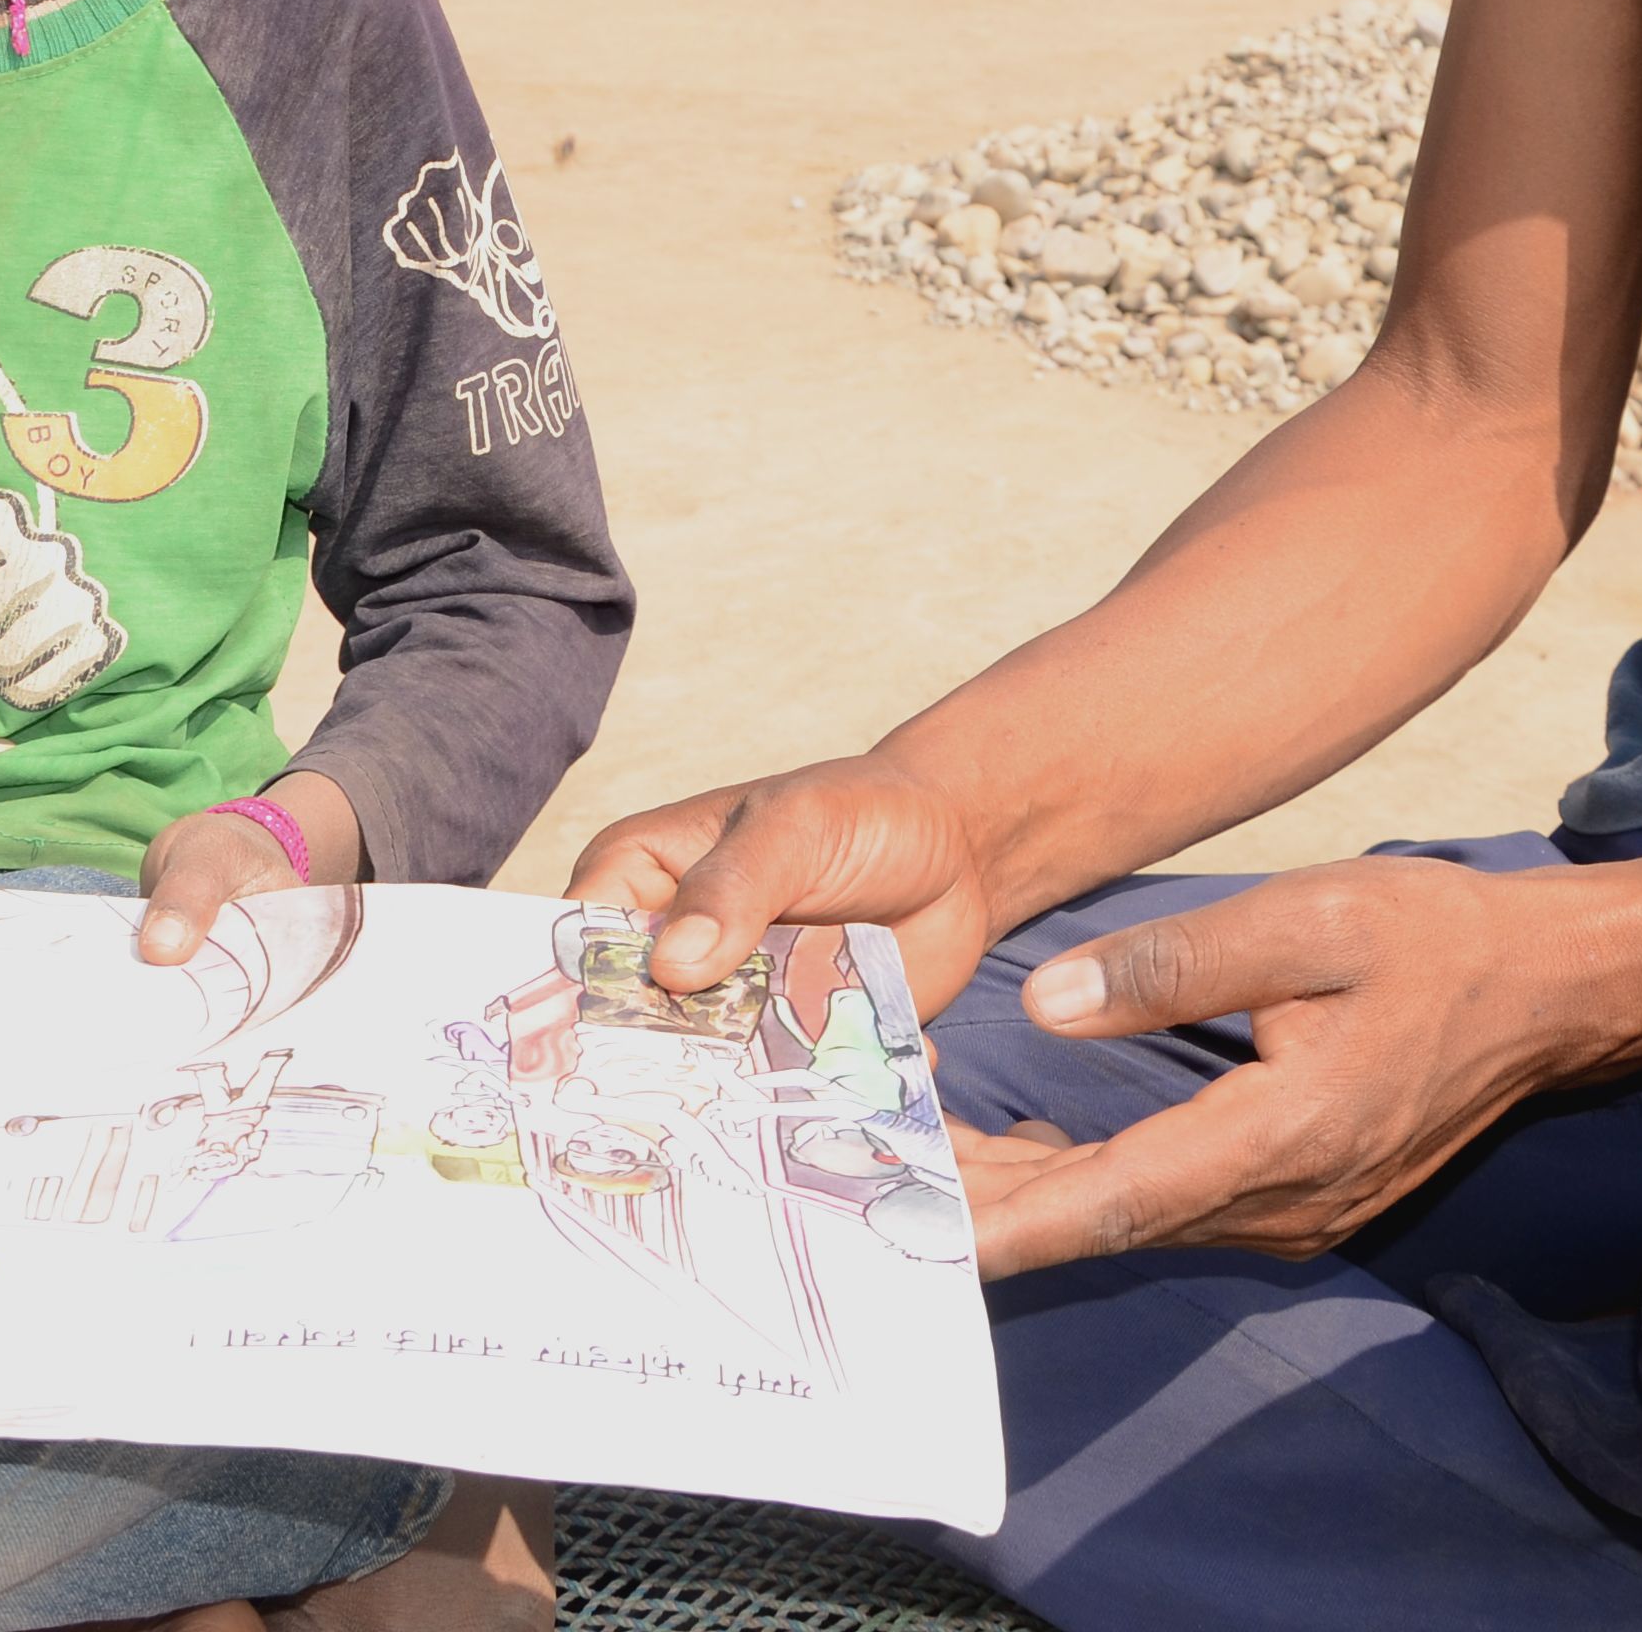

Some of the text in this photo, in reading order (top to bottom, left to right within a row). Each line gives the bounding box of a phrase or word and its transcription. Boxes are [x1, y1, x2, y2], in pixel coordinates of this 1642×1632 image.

[120, 264, 181, 360] SPORT
[0, 244, 215, 503] 3
[455, 338, 583, 456] TRA
[27, 424, 96, 491] BOY
